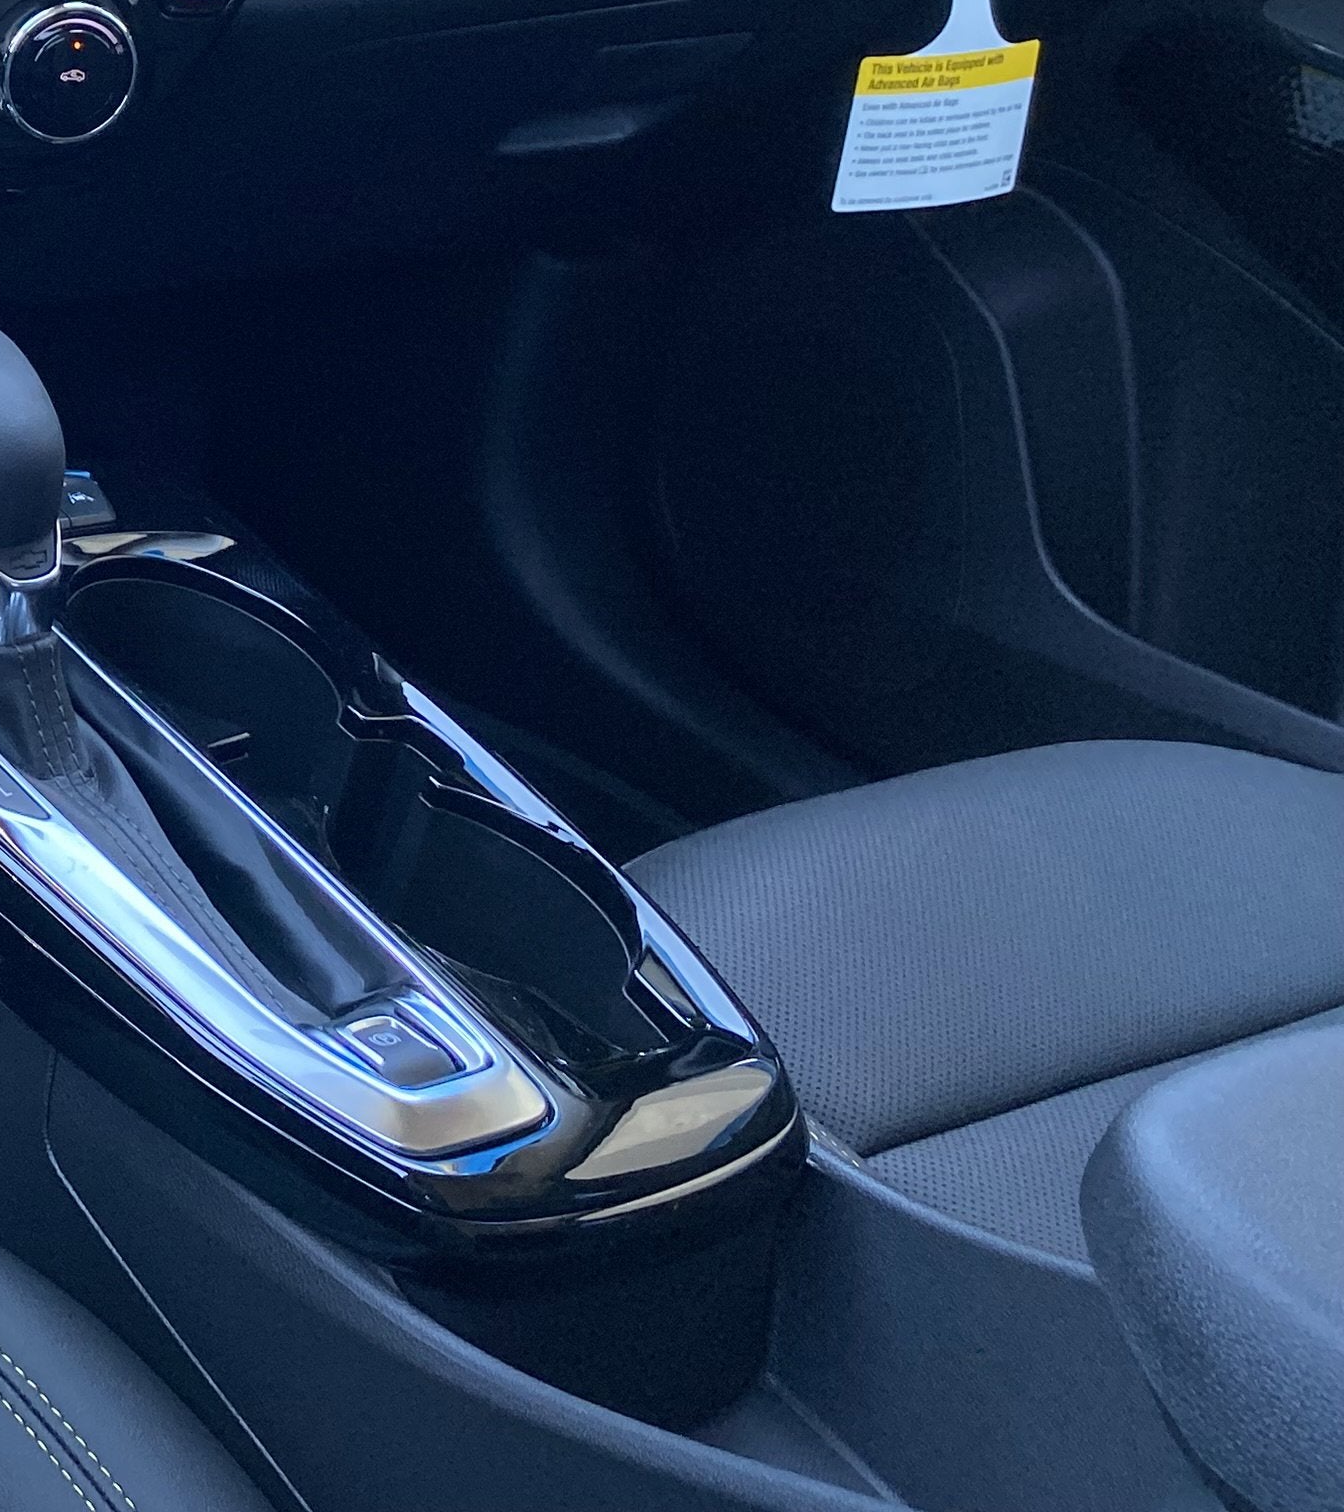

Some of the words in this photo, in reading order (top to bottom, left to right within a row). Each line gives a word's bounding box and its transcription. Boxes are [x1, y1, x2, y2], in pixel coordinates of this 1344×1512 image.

[872, 63, 893, 75] This
[896, 61, 933, 75] Vehicle
[935, 61, 944, 73] is
[945, 56, 986, 73] Equipped
[987, 53, 1005, 65] with
[867, 77, 919, 90] Advanced
[920, 76, 935, 88] Air
[937, 75, 961, 88] Bags
